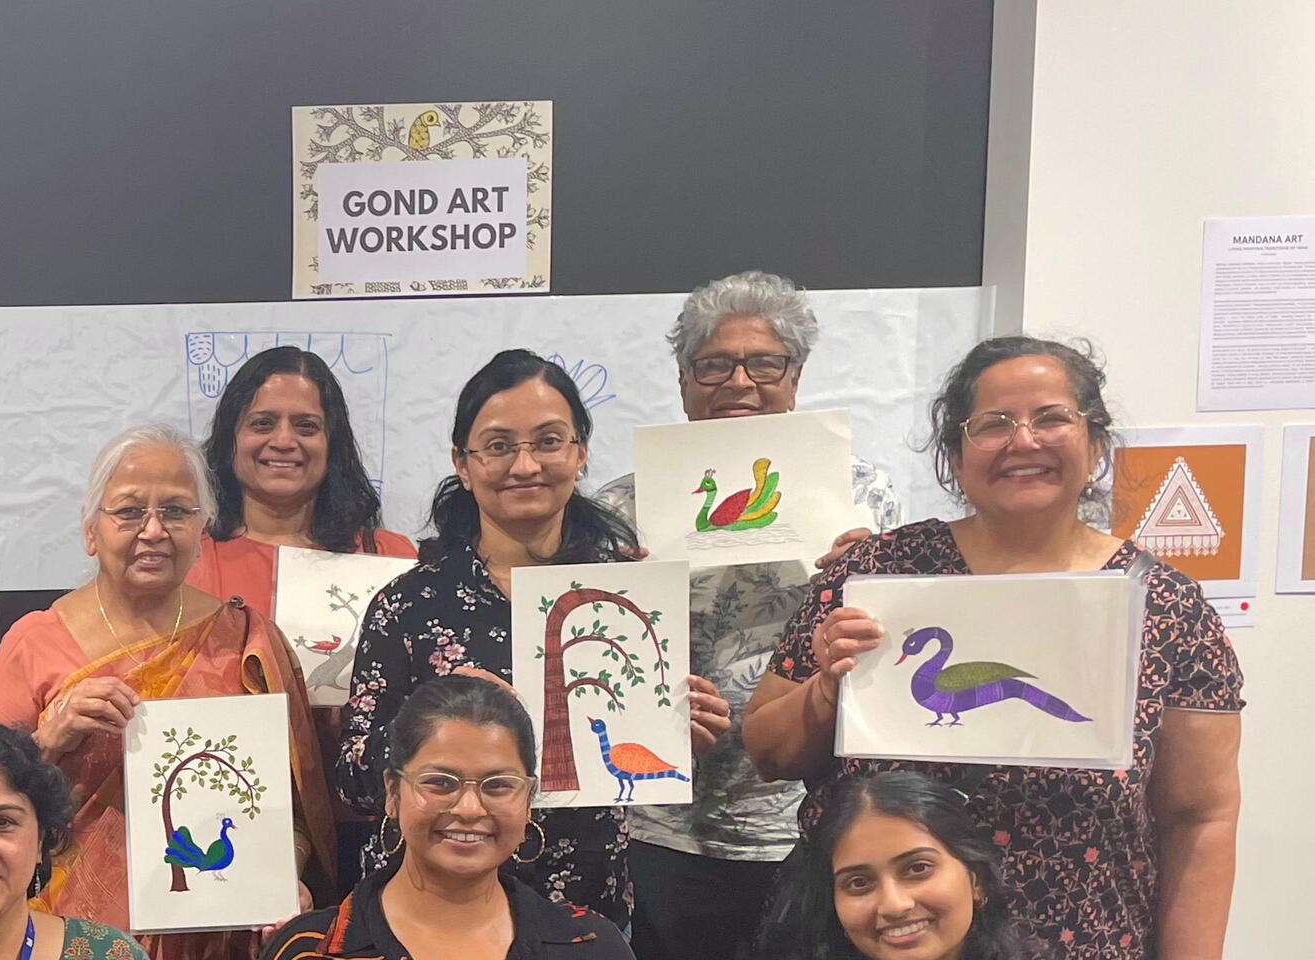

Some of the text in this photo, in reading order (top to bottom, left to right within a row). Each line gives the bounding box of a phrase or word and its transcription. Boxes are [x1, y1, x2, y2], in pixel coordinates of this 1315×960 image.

[342, 186, 510, 217] GOND ART
[325, 222, 517, 254] WORKSHOP
[1232, 234, 1304, 244] MANDANA ART
